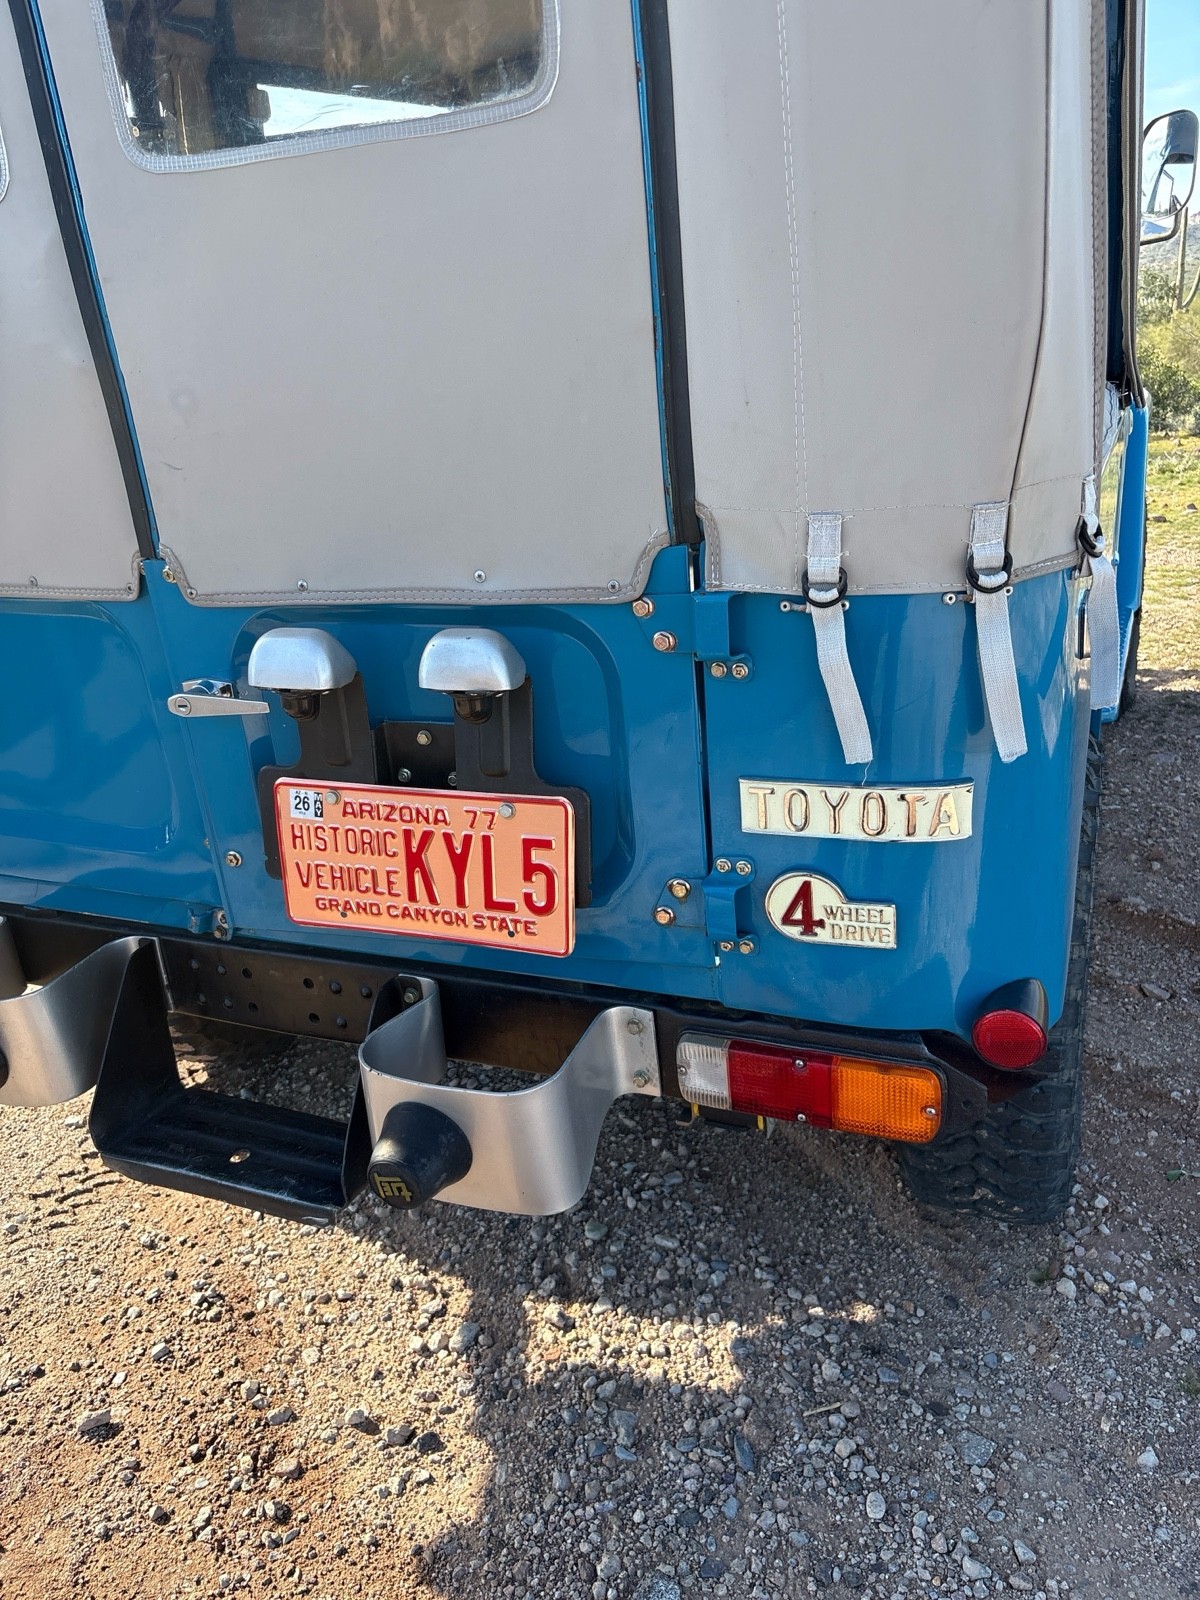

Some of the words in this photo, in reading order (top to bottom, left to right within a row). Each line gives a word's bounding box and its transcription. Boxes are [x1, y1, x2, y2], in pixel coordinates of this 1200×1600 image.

[294, 795, 310, 811] 26
[314, 792, 323, 817] MAY
[342, 799, 449, 826] ARIZONA
[463, 806, 498, 829] 77
[748, 787, 961, 837] TOYOTA
[290, 822, 399, 858] HISTORIC
[295, 860, 401, 897] VEHICLE
[315, 895, 382, 917] GRAND
[387, 903, 468, 928] CANYON
[472, 913, 538, 936] STATE
[781, 880, 826, 937] 4
[822, 904, 891, 925] WHEEL
[830, 923, 891, 944] DRIVE
